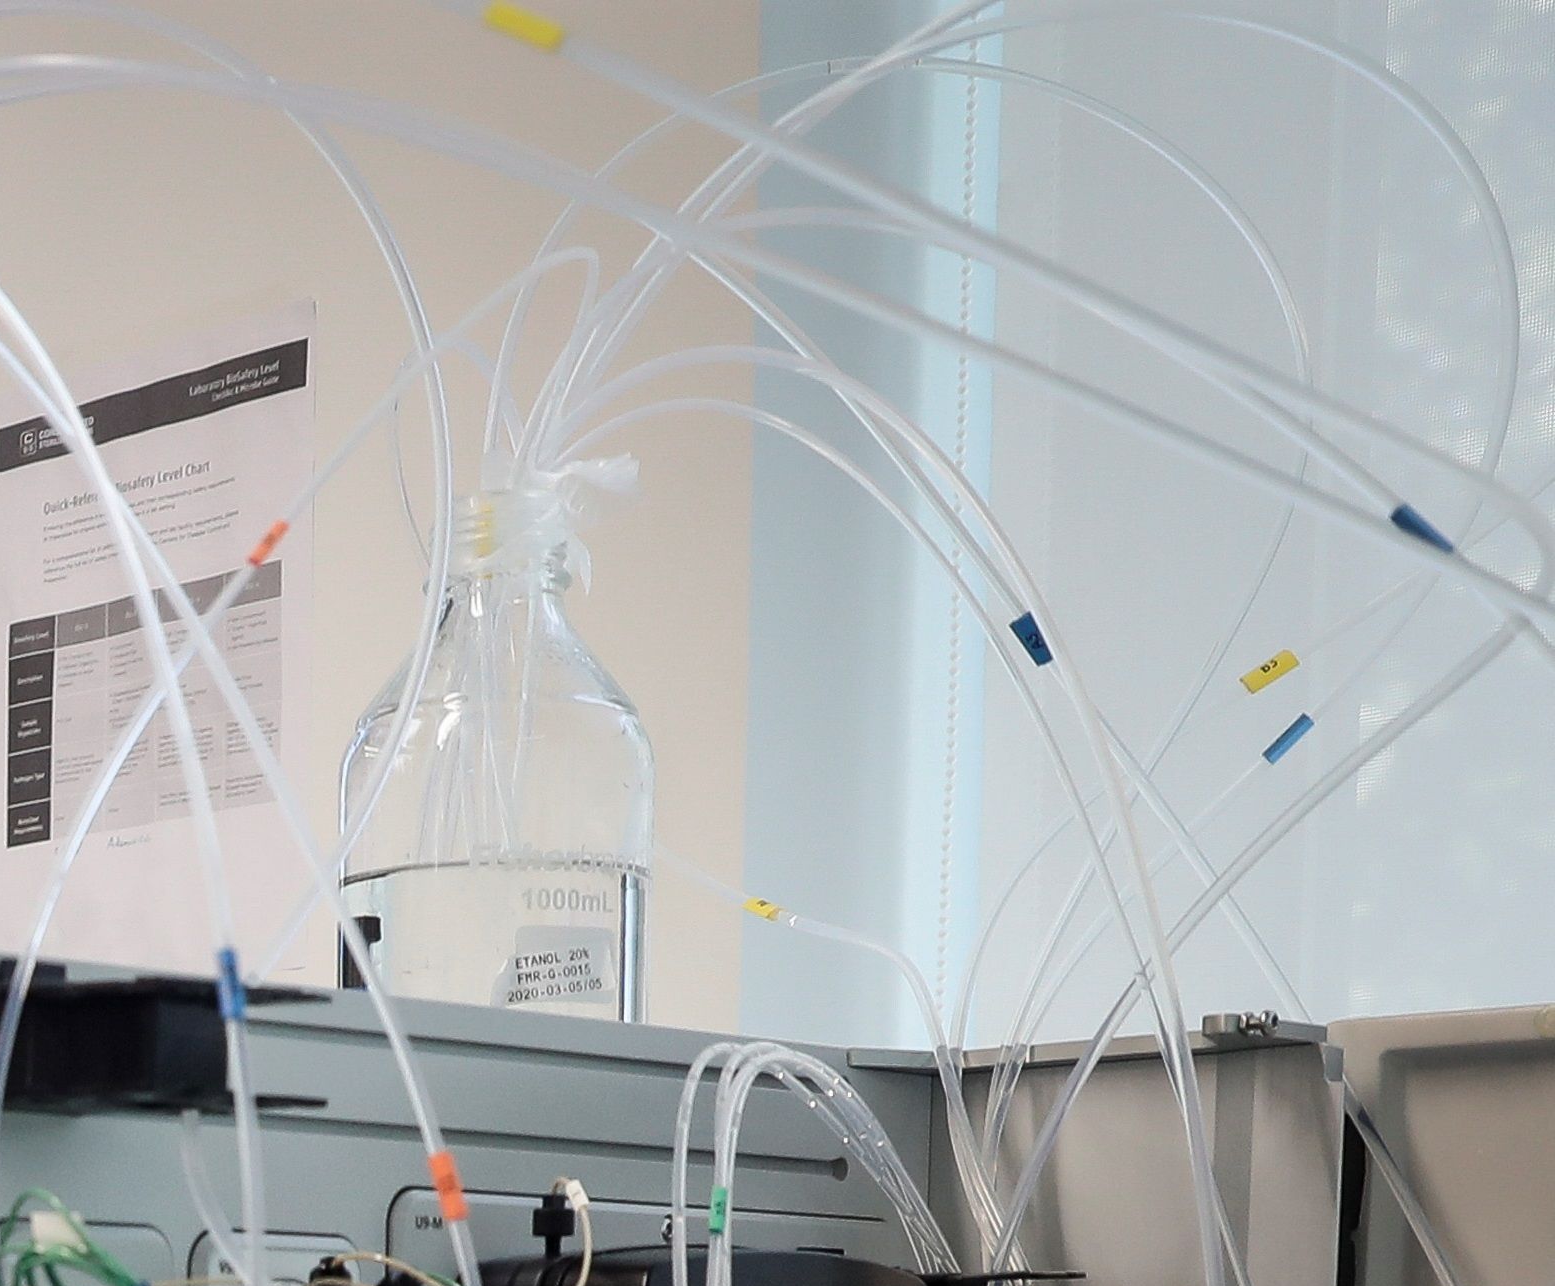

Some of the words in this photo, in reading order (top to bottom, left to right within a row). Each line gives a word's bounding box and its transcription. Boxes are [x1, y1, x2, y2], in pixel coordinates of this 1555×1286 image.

[158, 465, 183, 484] Level
[185, 460, 211, 477] Chart
[522, 888, 613, 913] 1000mL
[515, 951, 561, 970] ETANOL
